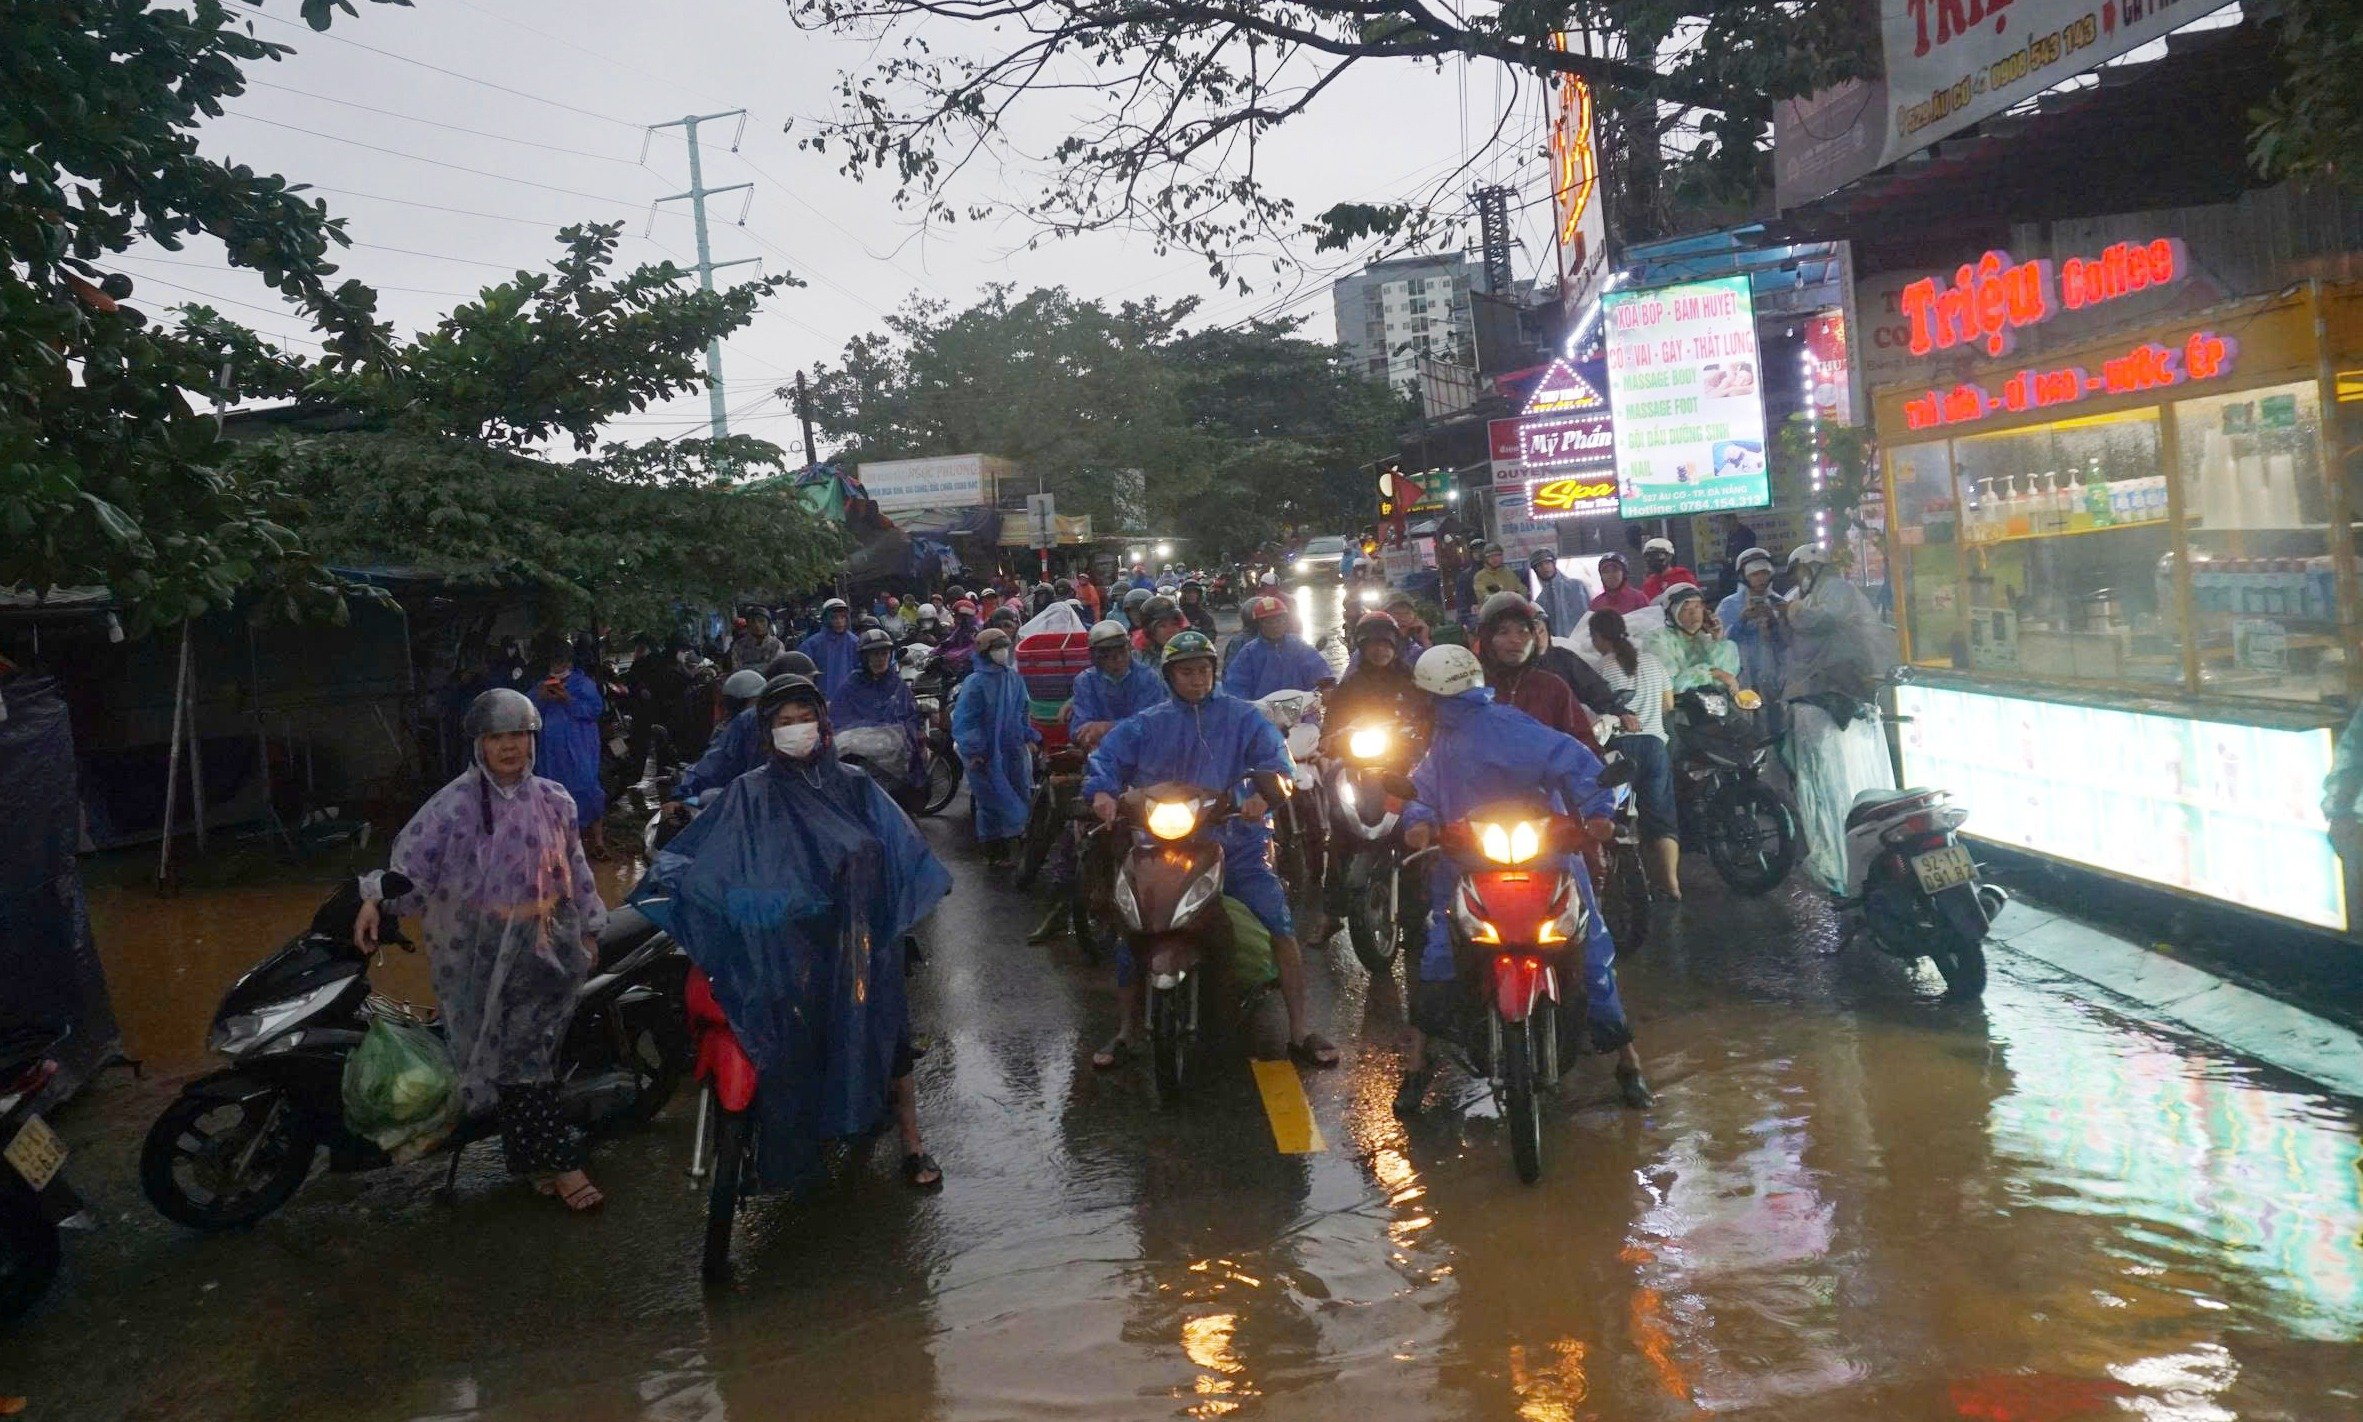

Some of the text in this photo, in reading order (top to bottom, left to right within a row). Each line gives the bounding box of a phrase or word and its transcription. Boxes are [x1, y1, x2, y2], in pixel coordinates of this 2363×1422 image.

[1901, 237, 2173, 357] Triệu Coffee
[1634, 344, 1651, 366] VAI
[1623, 367, 1697, 391] MASSAGE BODY
[1625, 396, 1698, 420] MASSAGE FOOT
[1531, 432, 1559, 457] Mỹ
[1534, 480, 1615, 509] Spa
[1628, 503, 1676, 517] Hotline:
